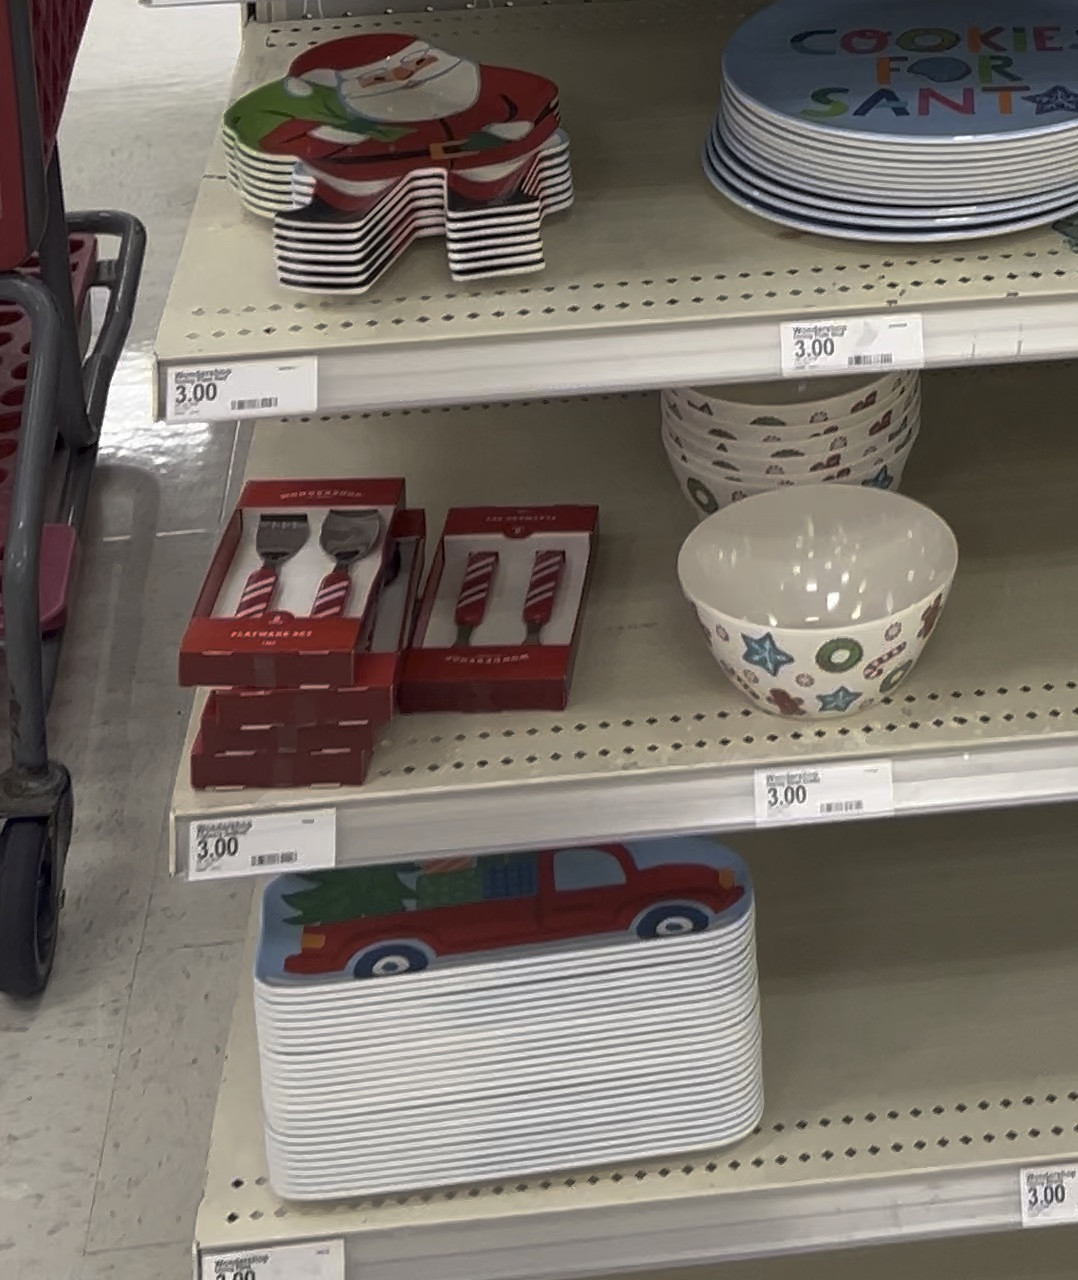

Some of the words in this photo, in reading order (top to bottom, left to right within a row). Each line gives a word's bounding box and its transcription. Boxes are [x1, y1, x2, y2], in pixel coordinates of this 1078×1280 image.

[794, 338, 835, 358] 3.00
[175, 383, 217, 403] 3.00
[767, 785, 807, 807] 3.00
[197, 837, 239, 859] 3.00
[1028, 1184, 1066, 1207] 3.00
